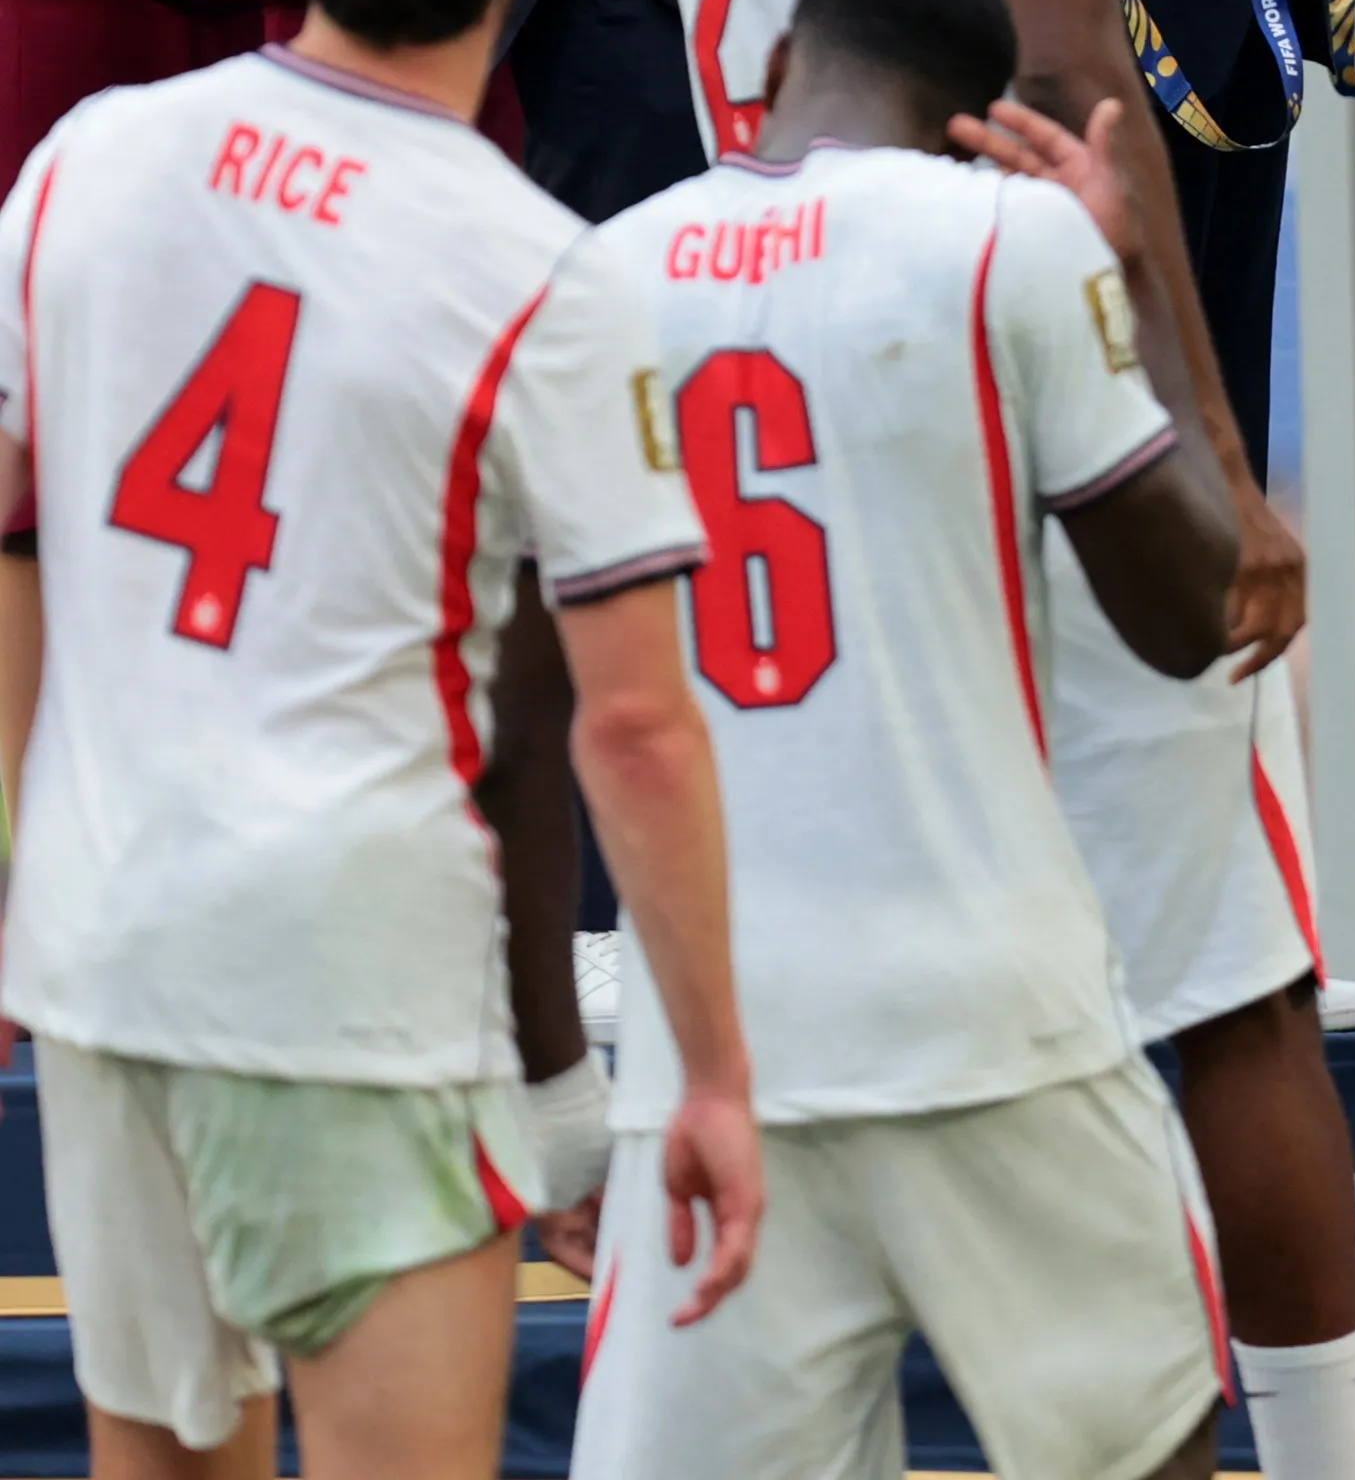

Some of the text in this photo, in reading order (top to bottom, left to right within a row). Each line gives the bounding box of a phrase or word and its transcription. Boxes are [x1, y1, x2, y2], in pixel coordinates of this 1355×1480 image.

[208, 121, 369, 228] RICE
[1276, 37, 1299, 77] FIFA
[106, 277, 304, 653] 4
[674, 345, 839, 712] 6
